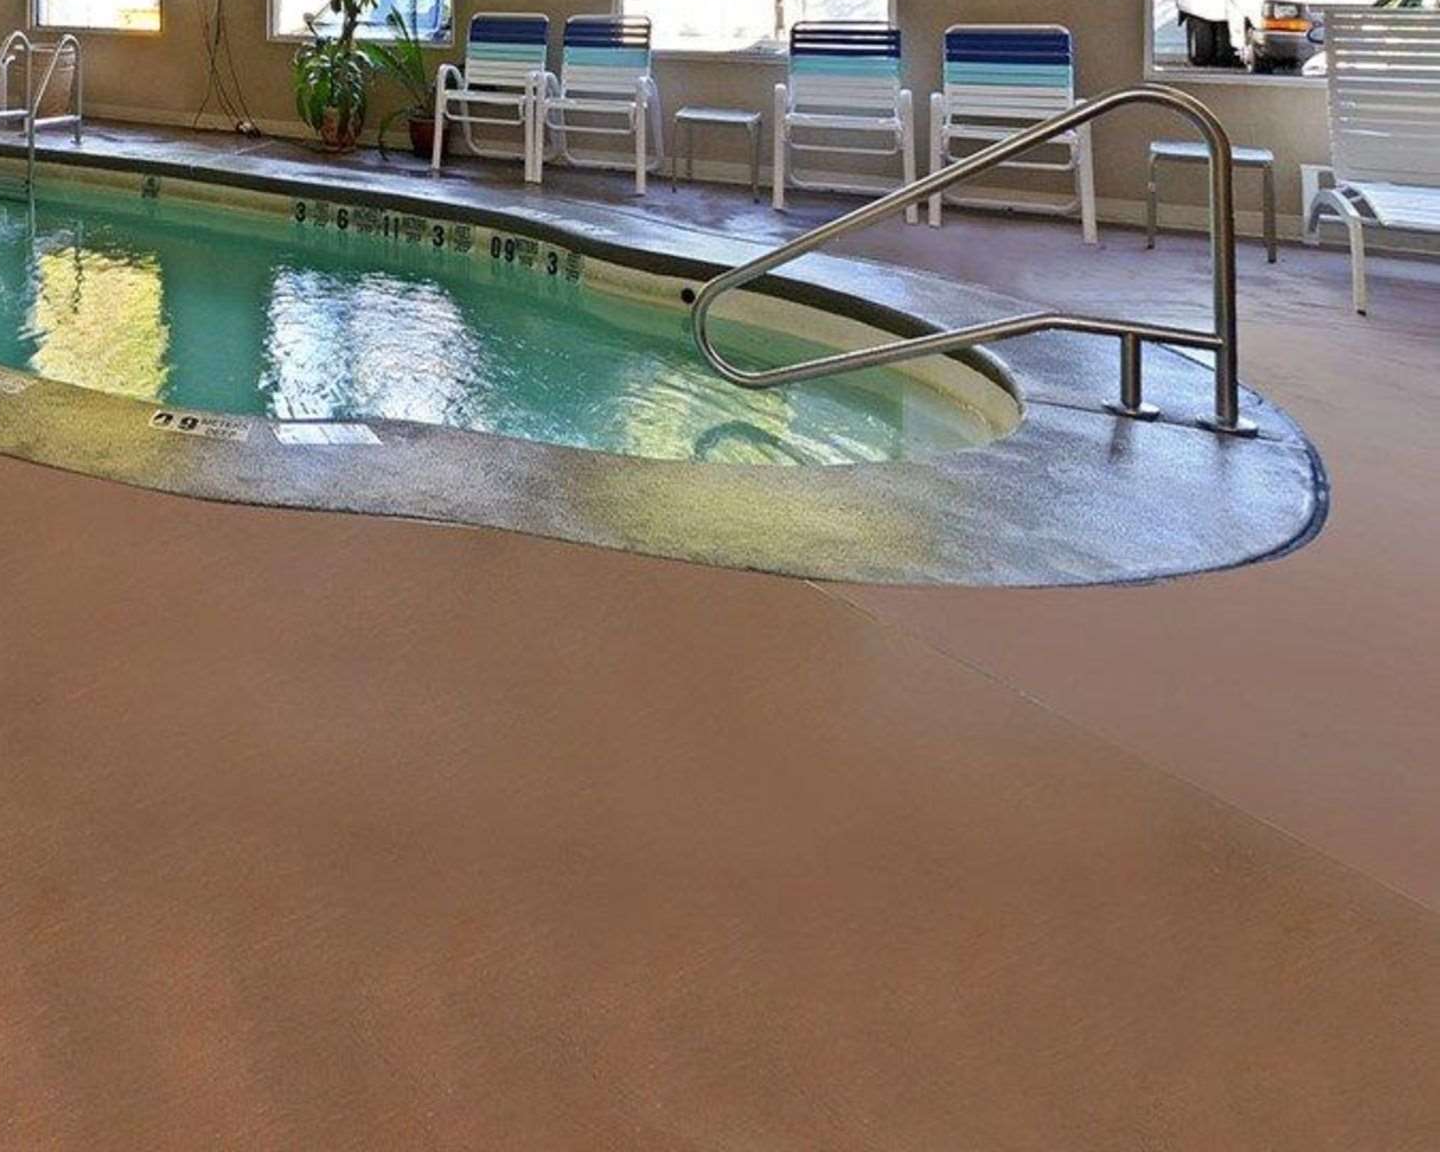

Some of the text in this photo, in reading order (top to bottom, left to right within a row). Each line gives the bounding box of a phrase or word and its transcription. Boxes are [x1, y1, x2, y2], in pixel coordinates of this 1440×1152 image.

[295, 201, 306, 222] 3
[337, 208, 349, 229] 6
[432, 224, 445, 247] 3
[547, 251, 558, 275] 3
